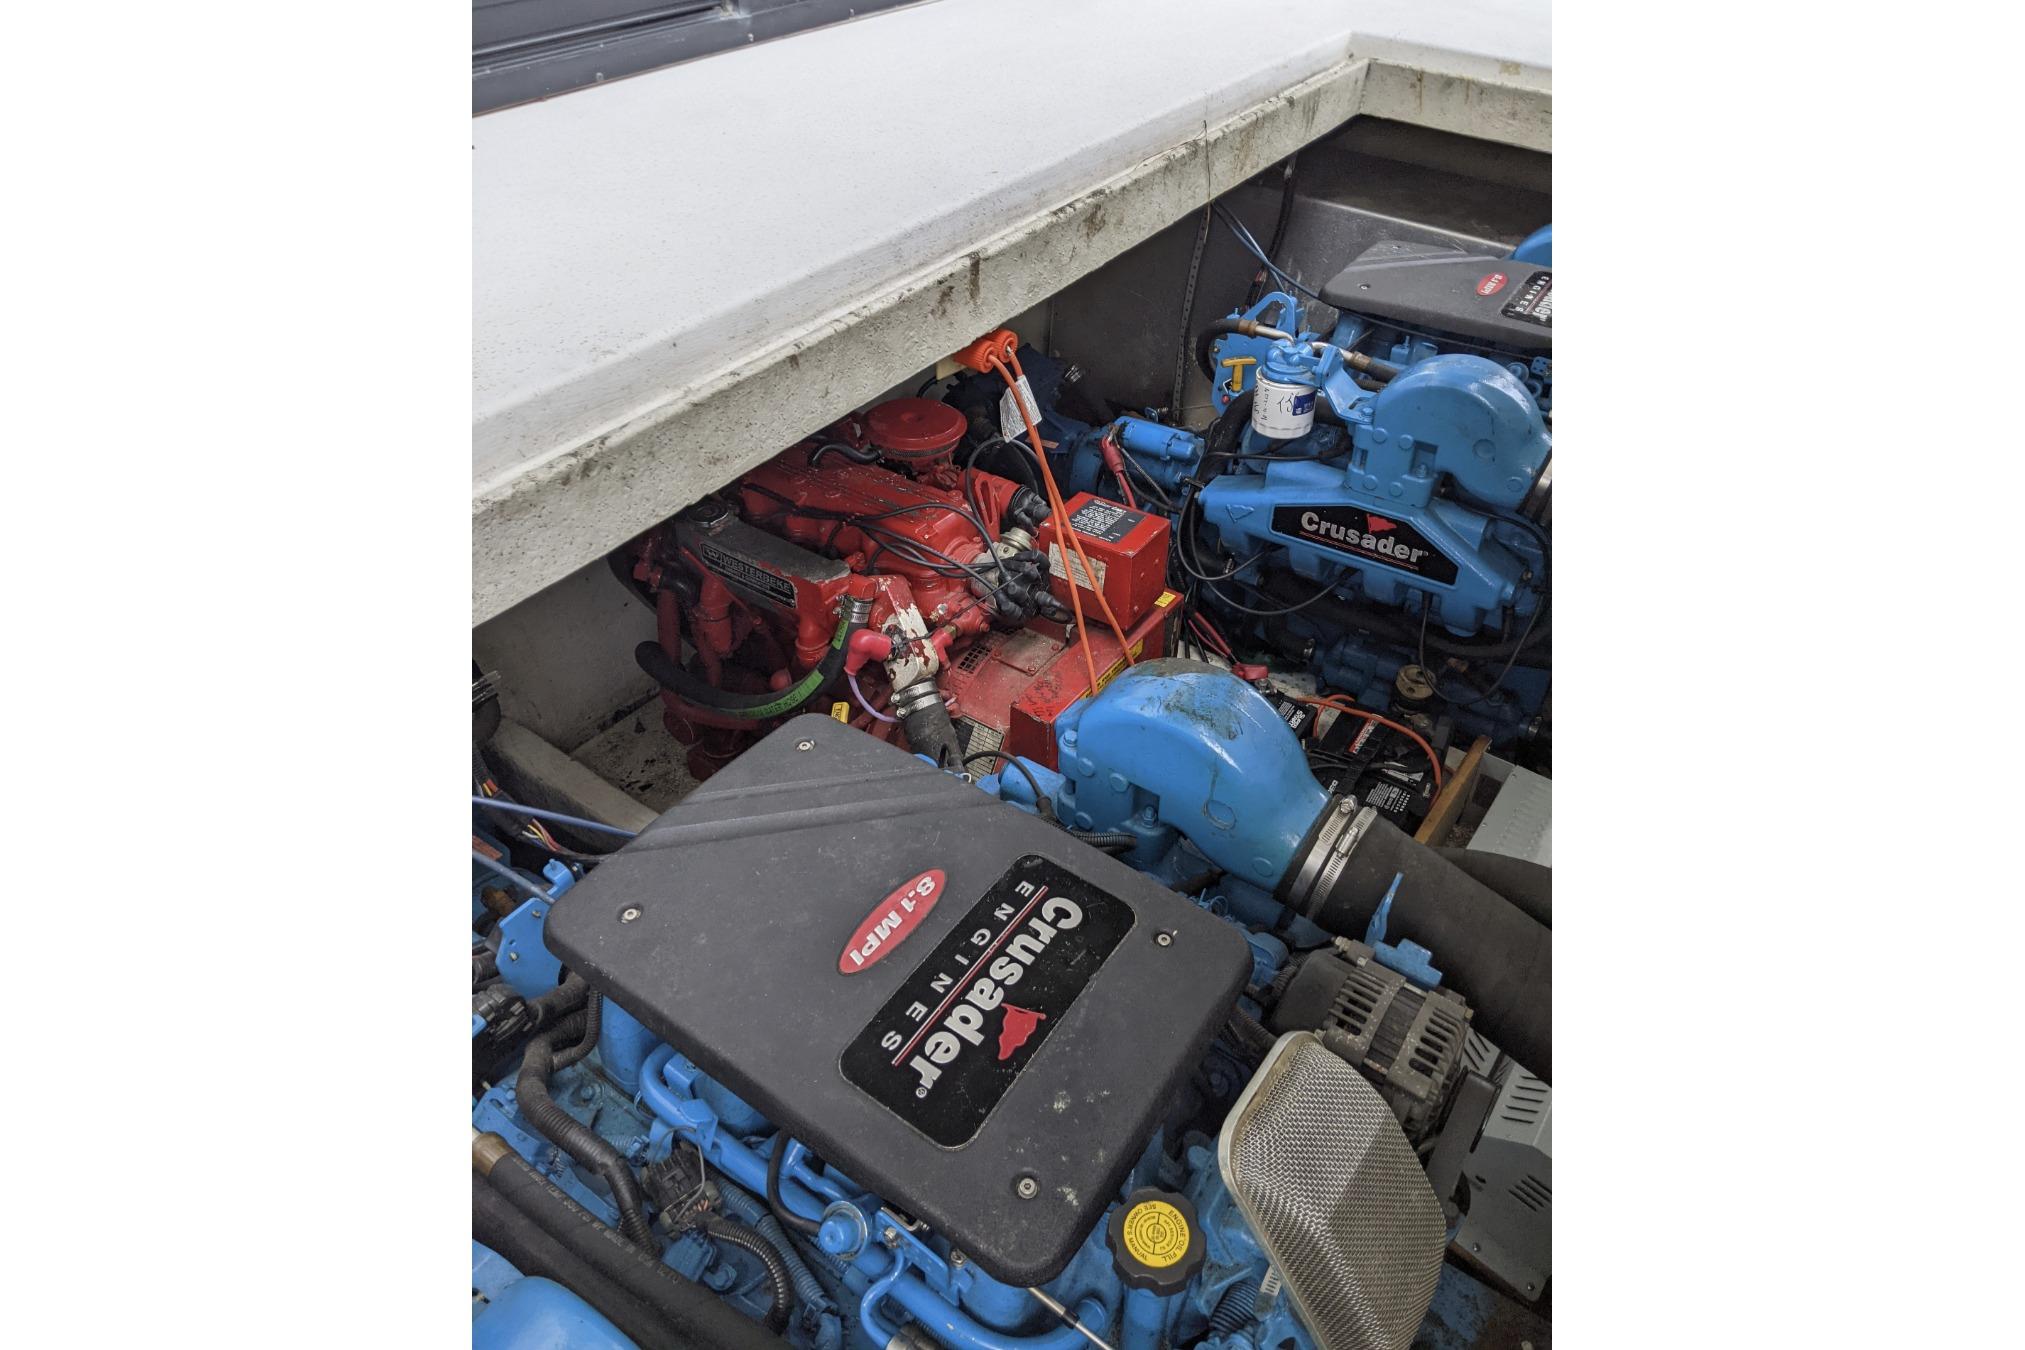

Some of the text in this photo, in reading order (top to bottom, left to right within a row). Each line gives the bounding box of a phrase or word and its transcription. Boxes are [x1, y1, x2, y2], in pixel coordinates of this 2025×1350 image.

[1515, 276, 1550, 312] ENGINES
[722, 552, 790, 593] WESTERBEKE
[849, 876, 937, 966] 8.1 MPI
[881, 880, 1035, 1051] ENGINES
[1161, 1209, 1185, 1262] ENGINE OIL FILL
